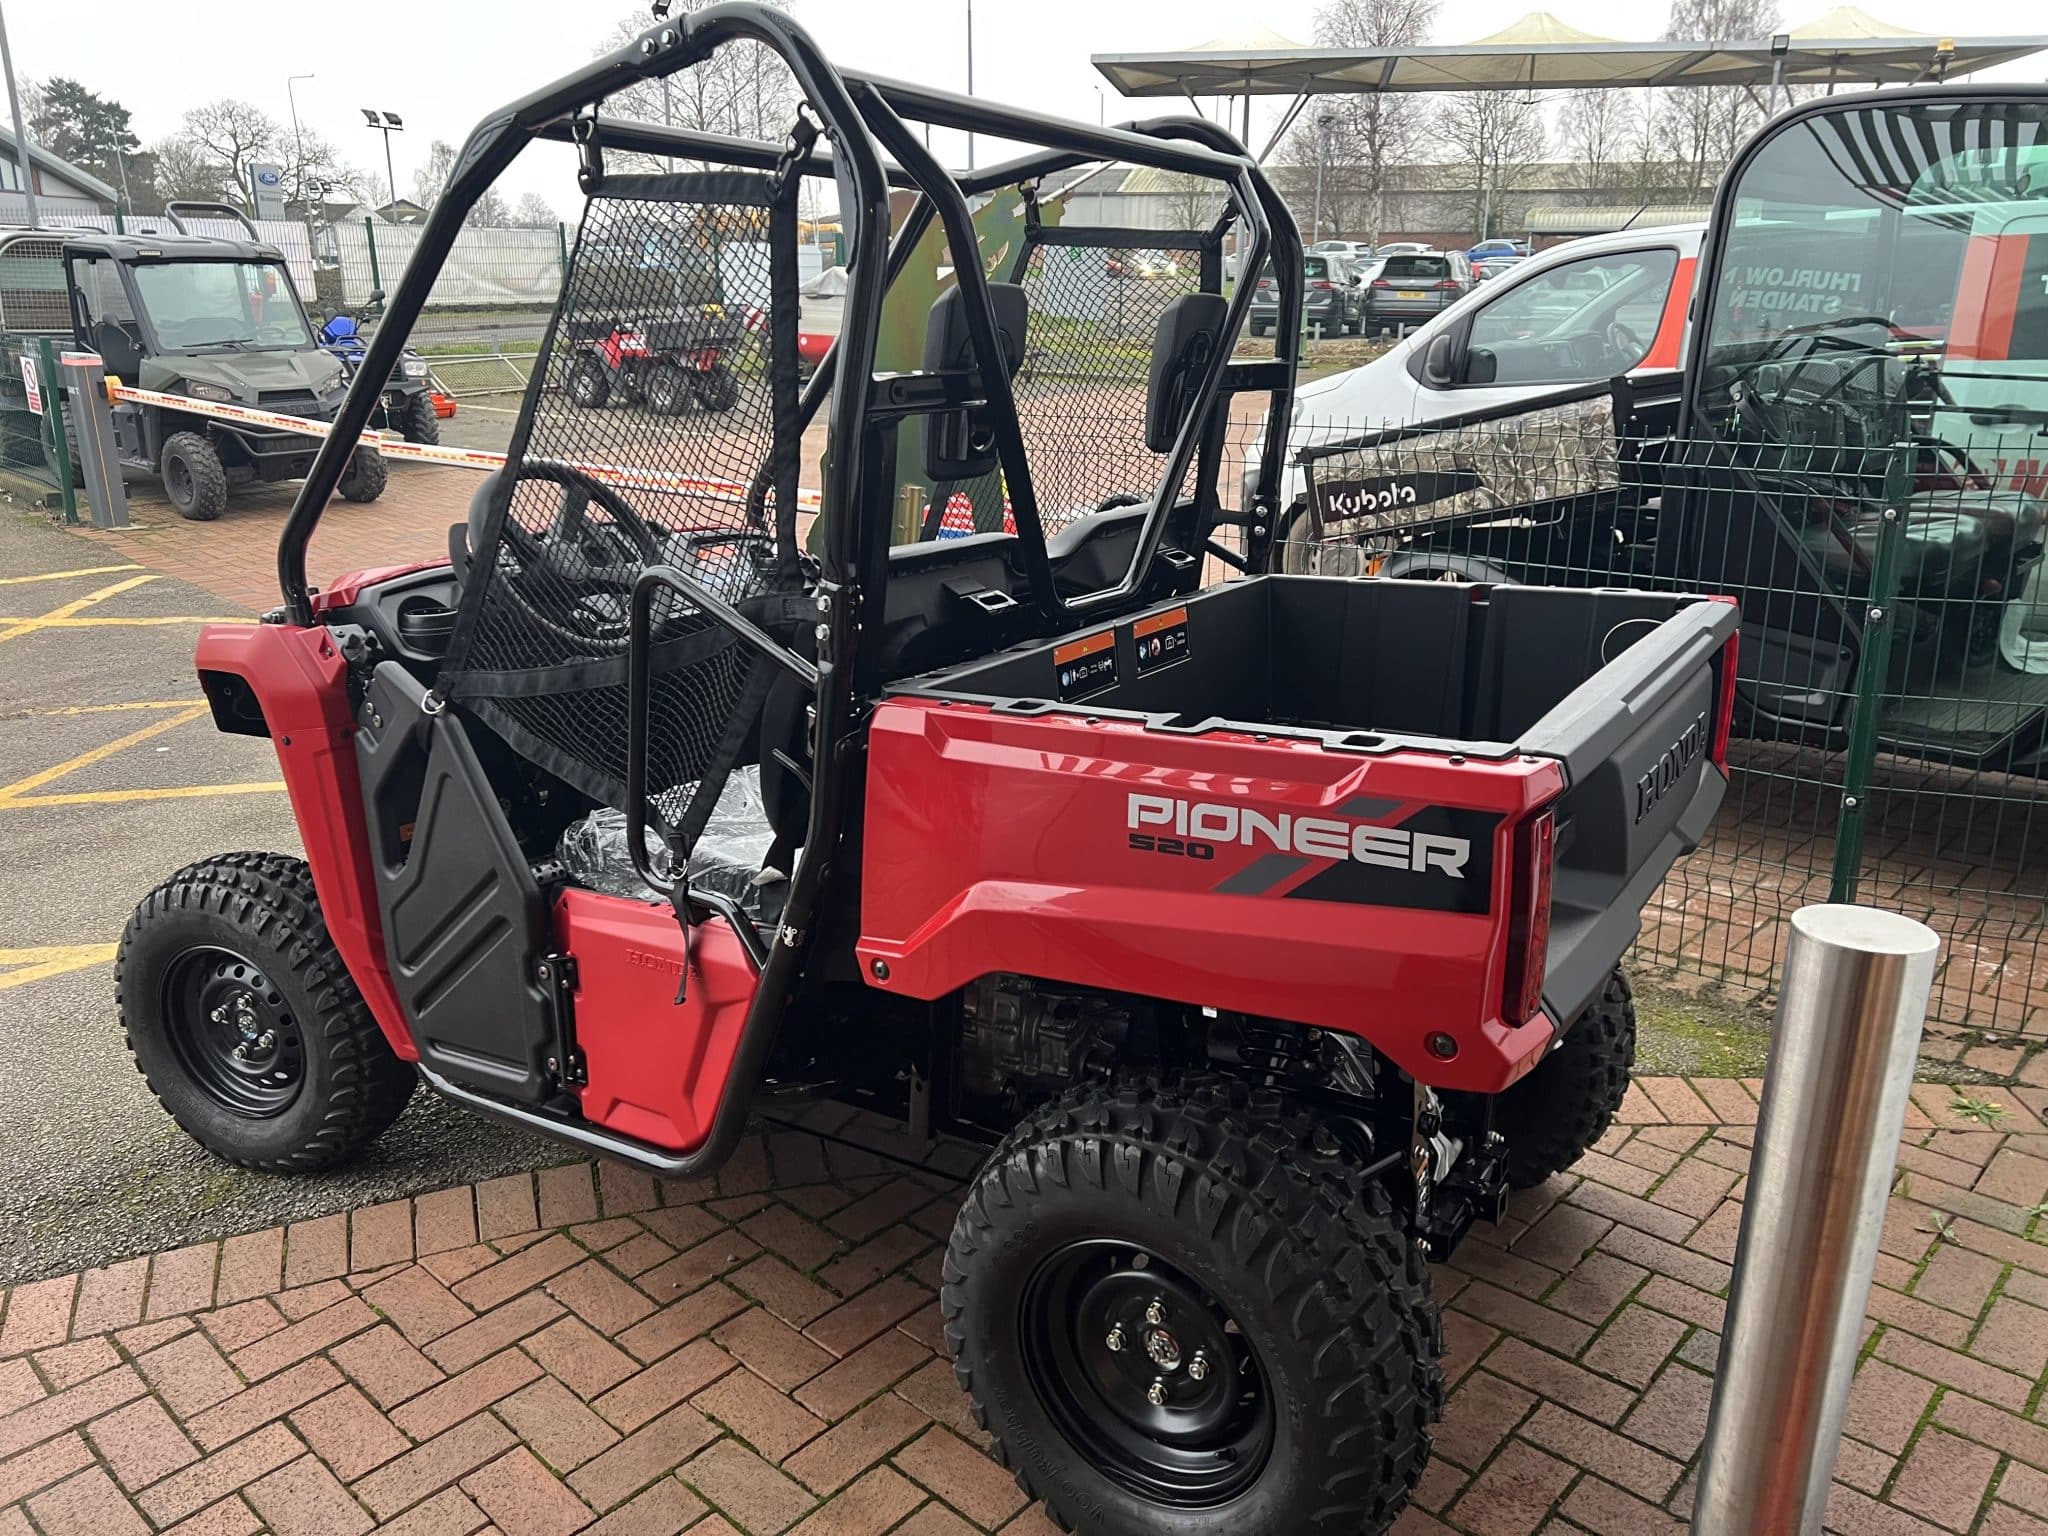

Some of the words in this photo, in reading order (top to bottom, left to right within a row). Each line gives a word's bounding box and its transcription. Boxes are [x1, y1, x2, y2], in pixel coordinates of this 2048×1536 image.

[1328, 482, 1417, 515] Kubota
[1634, 711, 1706, 825] HONDA
[1127, 792, 1471, 879] PIONEER
[1128, 833, 1215, 861] 520
